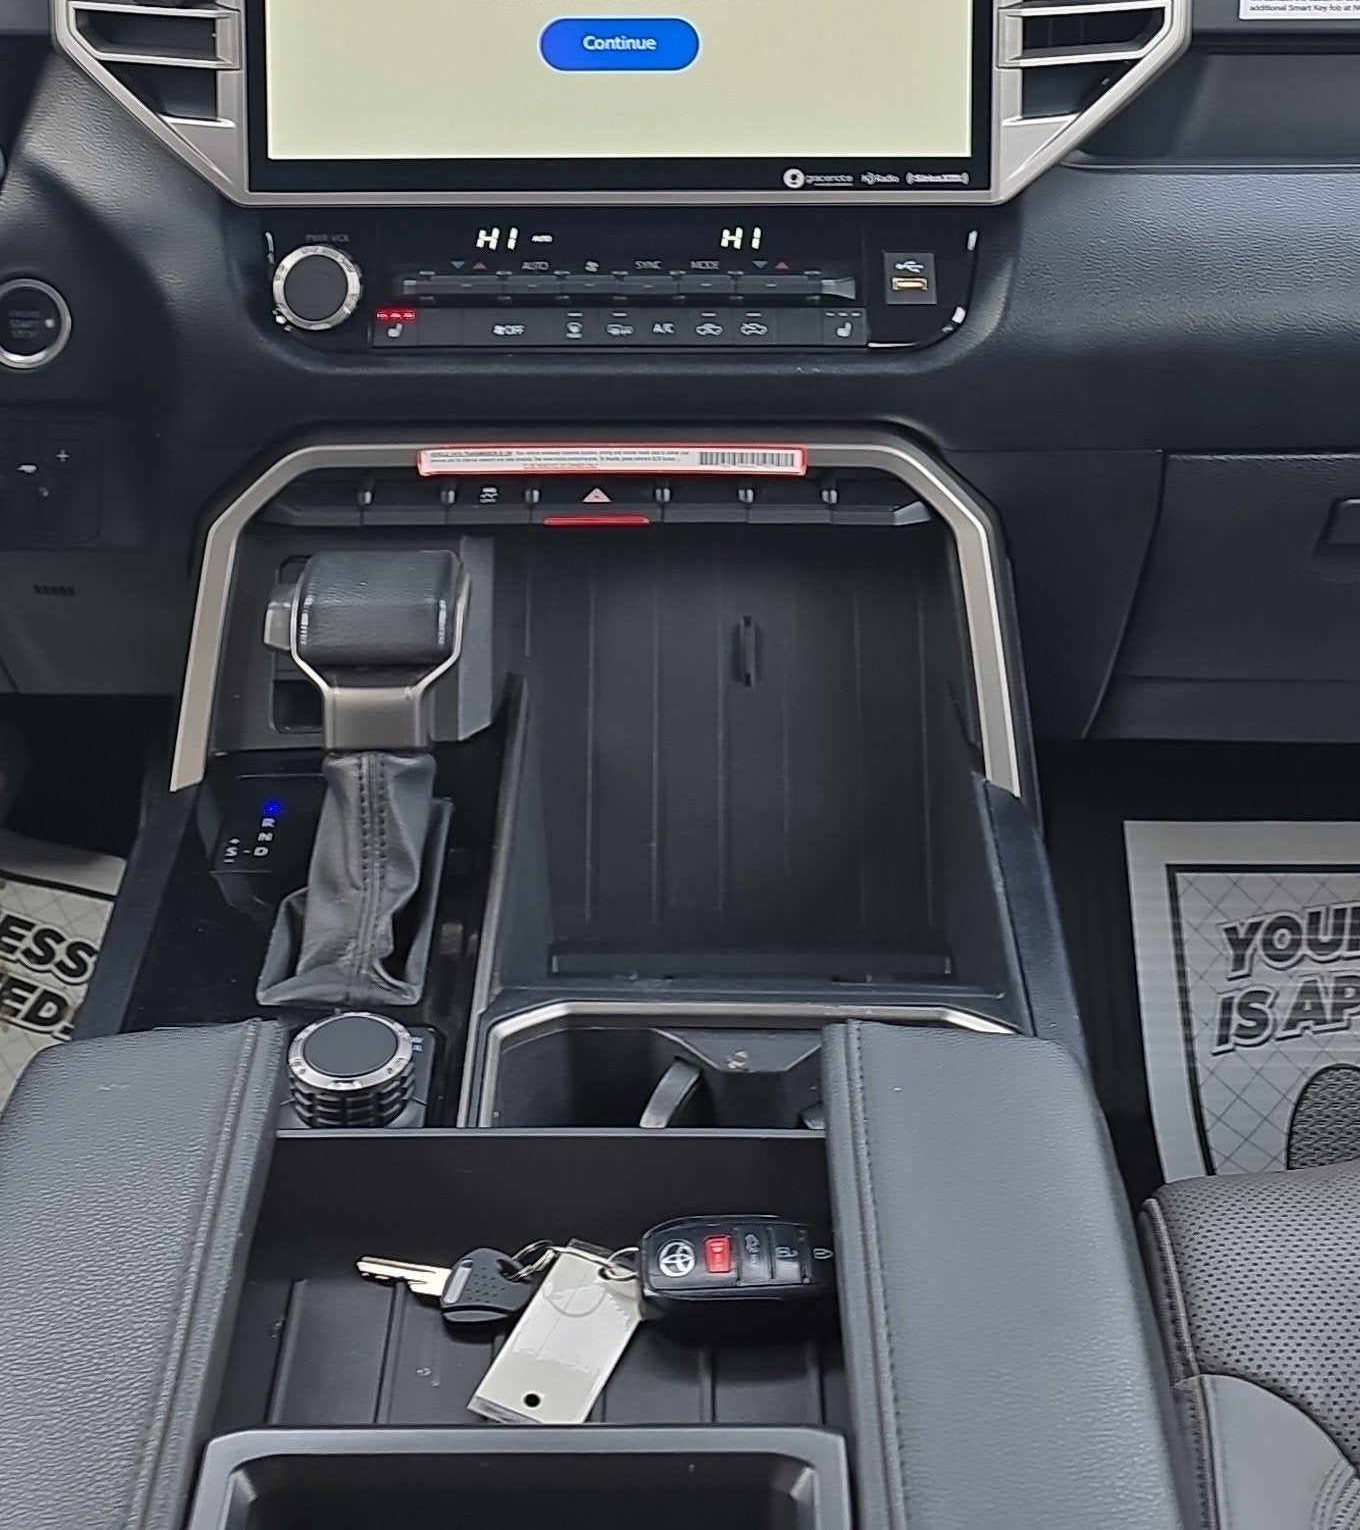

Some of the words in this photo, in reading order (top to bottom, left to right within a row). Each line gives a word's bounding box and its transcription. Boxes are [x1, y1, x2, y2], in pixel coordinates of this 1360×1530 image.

[582, 35, 657, 51] Continue
[476, 227, 518, 250] HI
[720, 227, 762, 250] HI
[635, 260, 663, 270] SYNC
[690, 260, 720, 270] MODE
[653, 323, 675, 336] A/C
[253, 846, 269, 857] D
[1212, 985, 1280, 1054] IS
